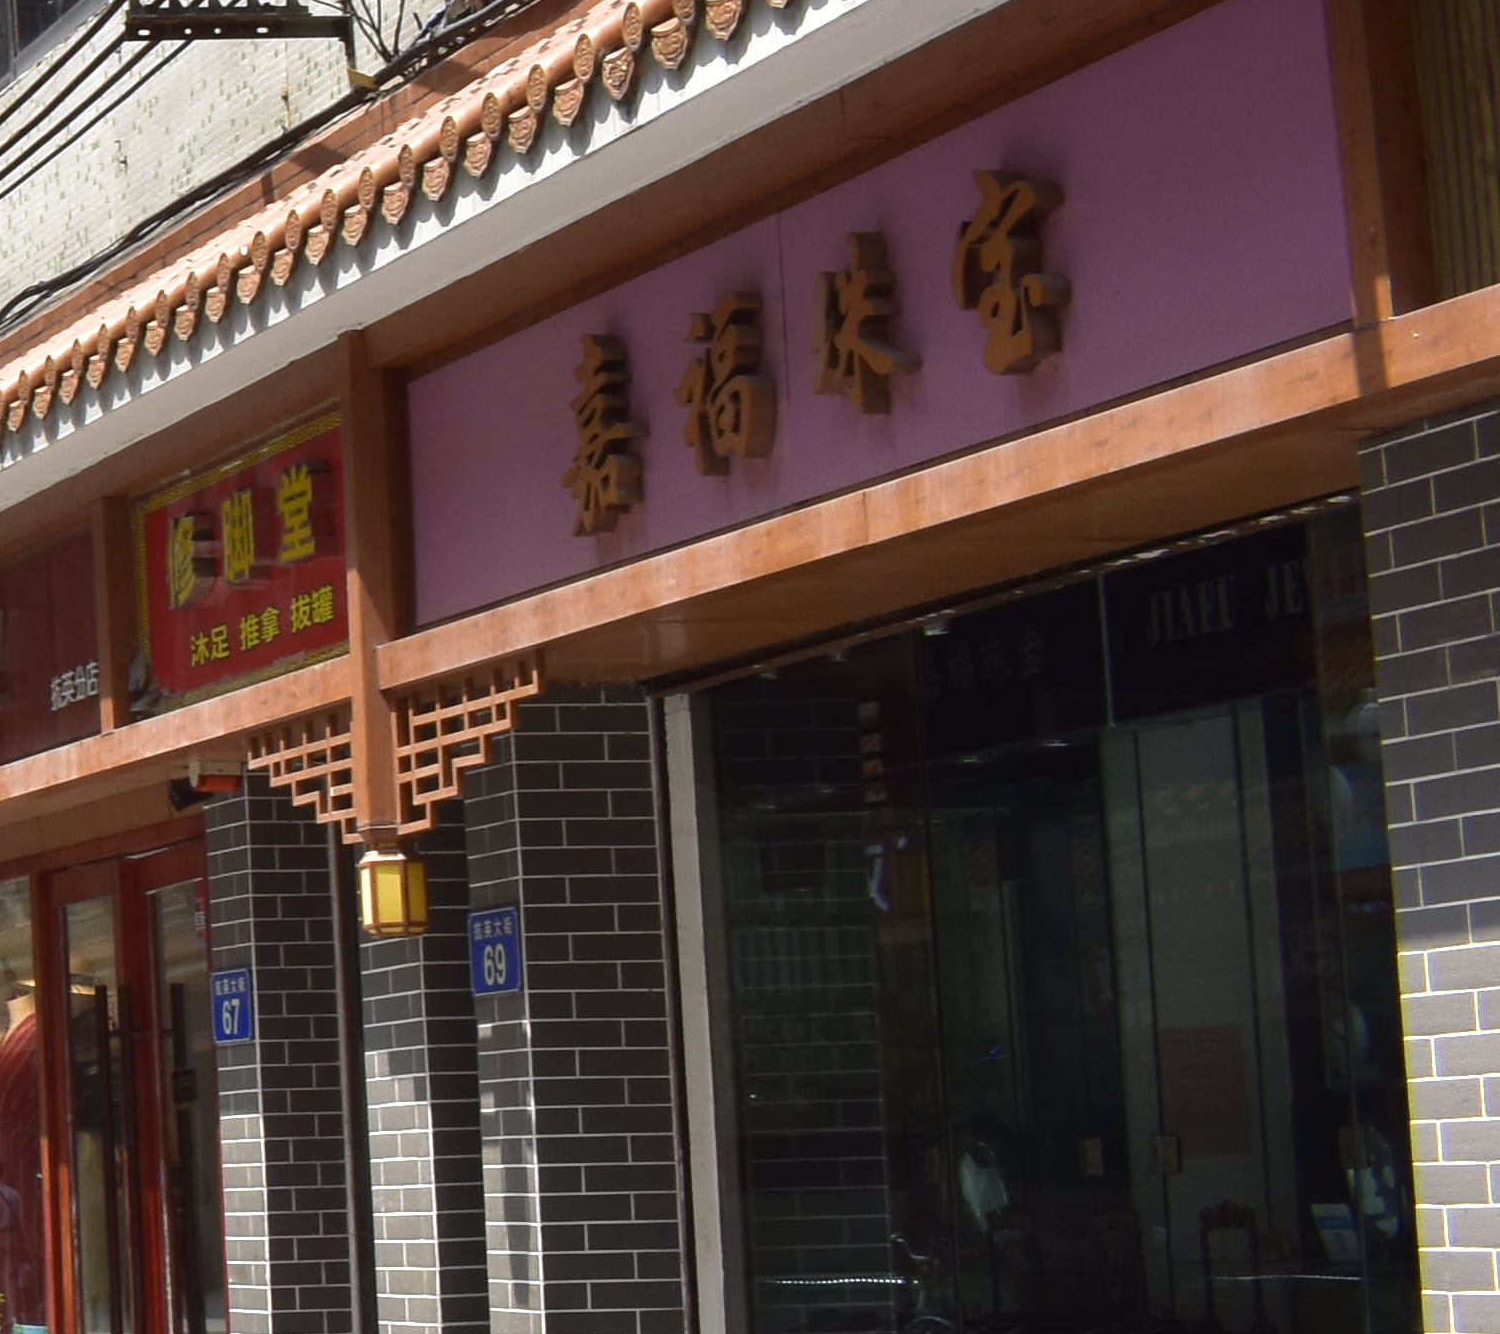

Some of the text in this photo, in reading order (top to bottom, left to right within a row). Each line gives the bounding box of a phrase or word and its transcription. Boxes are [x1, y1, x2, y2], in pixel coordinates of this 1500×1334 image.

[561, 169, 1071, 536] 嘉福珠宝
[169, 461, 316, 610] 修脚堂
[190, 585, 334, 666] 沐足 推拿 拔罐
[483, 943, 506, 986] 69
[222, 999, 239, 1035] 67
